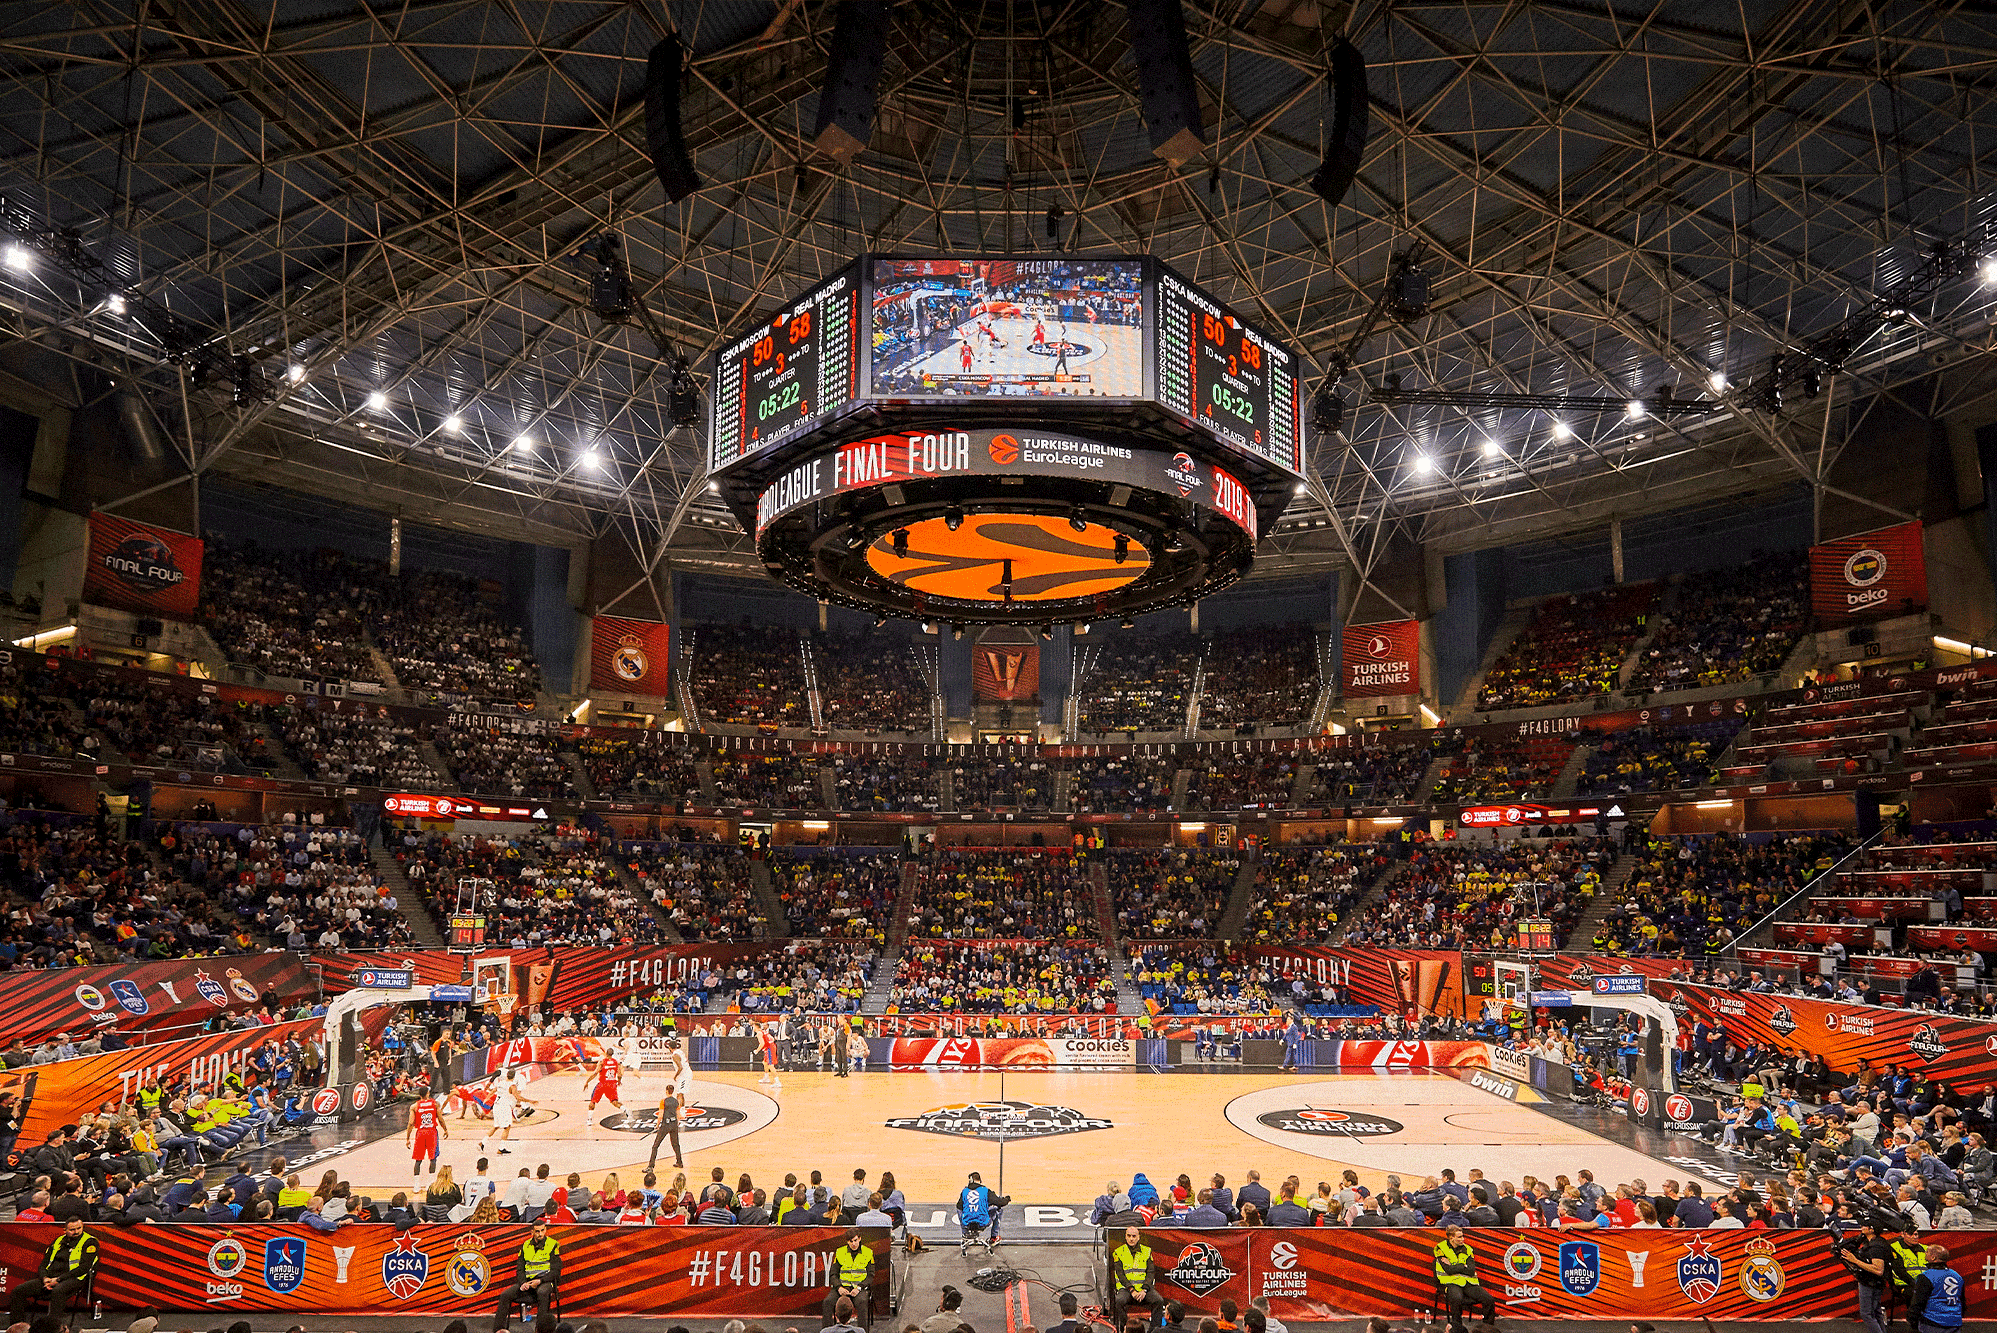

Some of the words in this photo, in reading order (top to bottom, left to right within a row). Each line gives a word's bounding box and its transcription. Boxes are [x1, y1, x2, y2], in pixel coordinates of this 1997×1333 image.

[794, 298, 815, 318] REAL
[815, 276, 846, 304] MADRID
[1163, 274, 1186, 298] CSKA
[1186, 289, 1221, 319] MOSCOW
[721, 344, 739, 363] CSKA
[739, 324, 770, 351] MOSCOW
[753, 336, 773, 367] 50
[789, 312, 811, 345] 58
[1203, 313, 1225, 347] 50
[1241, 337, 1261, 369] 58
[1245, 327, 1264, 348] REAL
[1263, 340, 1288, 364] MADRID
[801, 343, 810, 355] TO
[1204, 345, 1213, 358] TO
[775, 352, 785, 375] 3
[1228, 354, 1238, 377] 3
[754, 373, 761, 383] TO
[768, 367, 796, 390] QUARTER
[1222, 372, 1249, 395] QUARTER
[758, 381, 800, 421] 05:22
[1212, 383, 1254, 425] 05:22
[1205, 403, 1213, 418] 4
[752, 426, 759, 440] 4
[767, 423, 791, 442] PLAYER
[1223, 426, 1246, 446] PLAYER
[1254, 429, 1262, 444] 5
[1022, 438, 1079, 452] TURKISH
[1080, 442, 1132, 459] AIRLINES
[834, 441, 893, 489] FINAL
[908, 432, 969, 473] FOUR
[1023, 450, 1104, 469] EuroLeague
[1215, 472, 1243, 521] 2019
[105, 555, 144, 576] FINAL
[148, 565, 184, 583] FOUR
[1847, 588, 1888, 605] beko
[1866, 644, 1879, 655] 10
[1353, 661, 1409, 675] TURKISH
[1352, 672, 1410, 687] AIRLINES
[1937, 668, 1978, 685] bwin
[303, 681, 314, 692] R
[330, 685, 341, 696] M
[1822, 683, 1861, 694] TURKISH
[1378, 706, 1386, 716] 9
[1519, 717, 1580, 737] #F4GLORY
[642, 730, 690, 747] 2019
[709, 735, 793, 752] TURKISH
[812, 741, 903, 755] AIRLINES
[923, 743, 1039, 758] EUROLEAGUE
[1132, 743, 1176, 757] FOUR
[400, 799, 430, 807] TURKISH
[1474, 810, 1500, 818] TURKISH
[1474, 815, 1500, 823] AIRLINES
[1529, 923, 1551, 933] 05:22
[458, 929, 473, 943] 14
[1537, 934, 1550, 948] 14
[377, 972, 407, 980] TURKISH
[1474, 967, 1487, 978] 50
[201, 983, 222, 993] CSKA
[1611, 978, 1641, 986] TURKISH
[1611, 984, 1642, 992] AIRLINES
[1720, 998, 1746, 1009] TURKISH
[90, 1012, 118, 1022] beko
[1719, 1006, 1746, 1016] AIRLINES
[1841, 1014, 1874, 1027] TURKISH
[1841, 1024, 1875, 1036] AIRLINES
[1066, 1040, 1130, 1052] Cookies
[1494, 1047, 1526, 1067] Cookies
[1471, 1071, 1514, 1099] bwin
[354, 1083, 362, 1105] 7
[317, 1090, 334, 1114] 7
[324, 1093, 338, 1112] DAYS
[1672, 1099, 1685, 1118] 7
[1680, 1101, 1690, 1119] DAYS
[1279, 1119, 1387, 1128] TURKISH
[1282, 1125, 1393, 1133] AIRLINES
[469, 1194, 477, 1207] 7
[968, 1204, 979, 1212] TV
[269, 1266, 300, 1275] ANADOLU
[388, 1259, 423, 1271] CSKA
[689, 1250, 834, 1288] #F4GLORY
[1683, 1263, 1716, 1275] CSKA
[272, 1273, 295, 1281] EFES
[1262, 1271, 1307, 1280] TURKISH
[1564, 1268, 1595, 1279] ANADOLU
[1569, 1275, 1591, 1285] EFES
[206, 1282, 243, 1295] beko
[1262, 1280, 1307, 1288] AIRLINES
[1505, 1284, 1542, 1298] beko
[1262, 1288, 1308, 1298] EuroLeague
